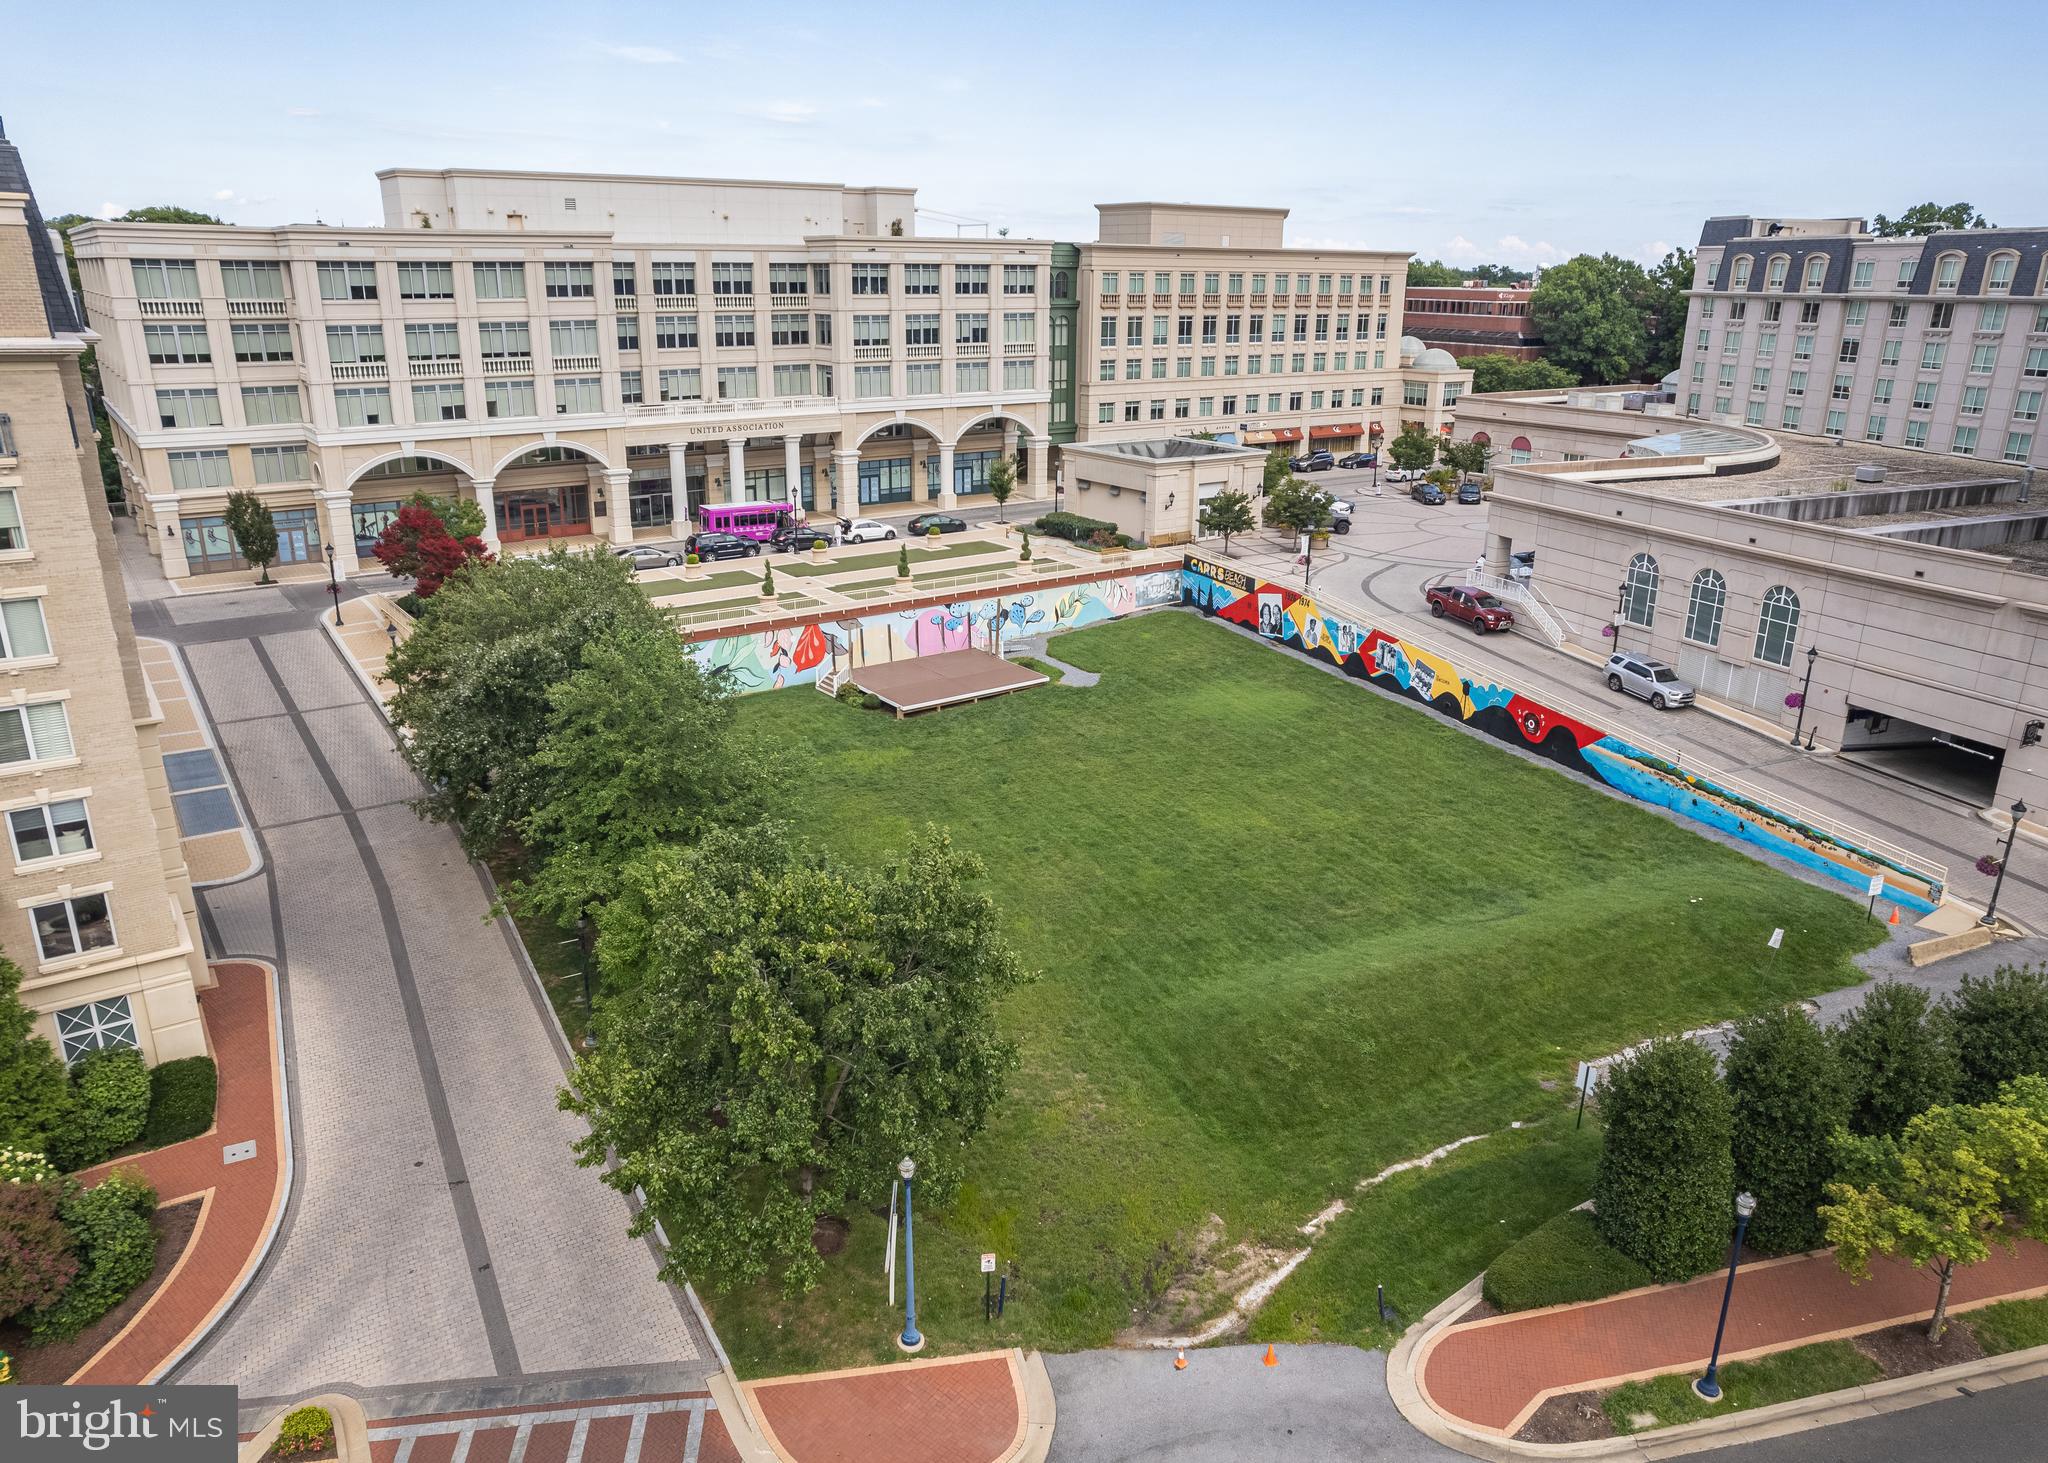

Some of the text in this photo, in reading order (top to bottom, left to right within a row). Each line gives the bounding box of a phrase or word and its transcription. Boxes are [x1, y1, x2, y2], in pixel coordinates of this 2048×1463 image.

[690, 422, 784, 435] UNITED ASSOCIATION
[1190, 558, 1225, 581] CARR'S
[1225, 569, 1247, 587] BEACH
